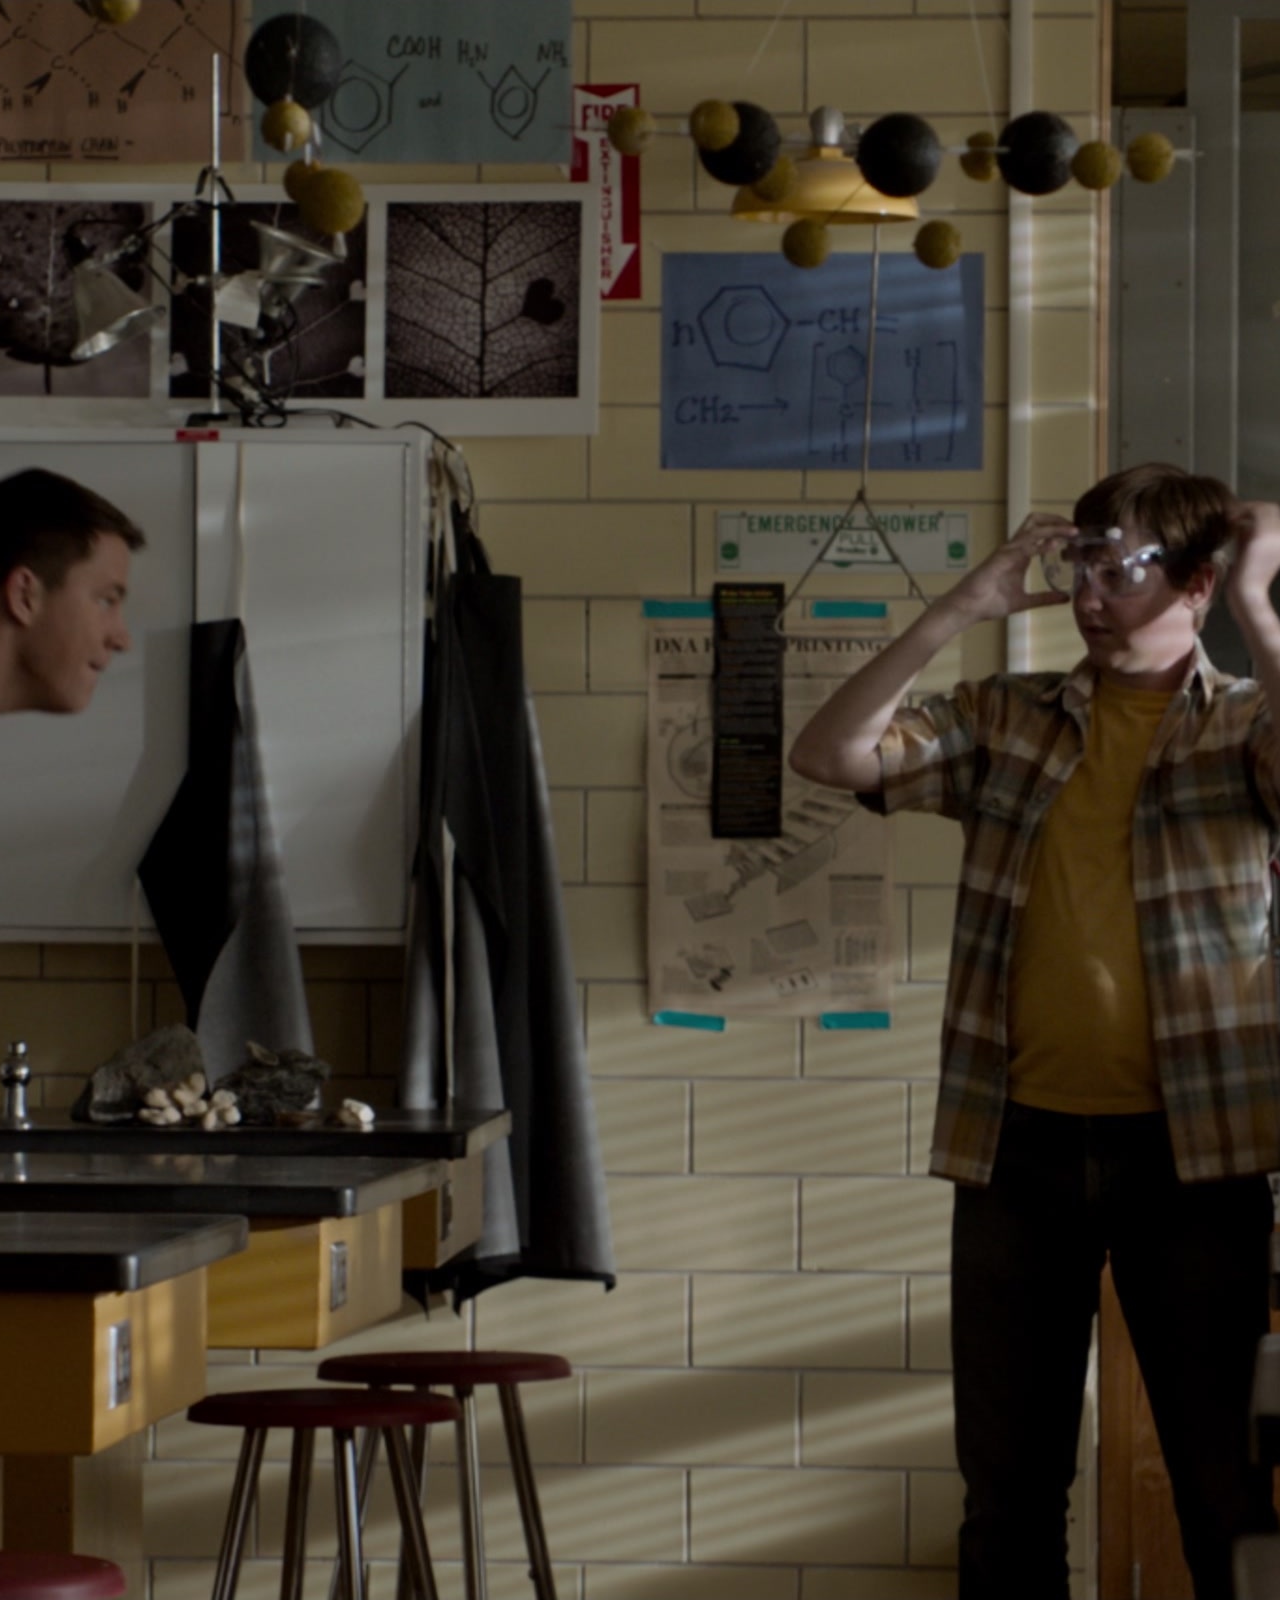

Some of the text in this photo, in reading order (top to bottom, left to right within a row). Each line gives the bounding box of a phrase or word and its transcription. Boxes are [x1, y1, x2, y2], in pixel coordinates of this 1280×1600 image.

[387, 34, 442, 59] COOH
[582, 104, 628, 131] FIR
[747, 514, 939, 533] EMERGENCY SHOWER
[655, 638, 697, 653] DNA
